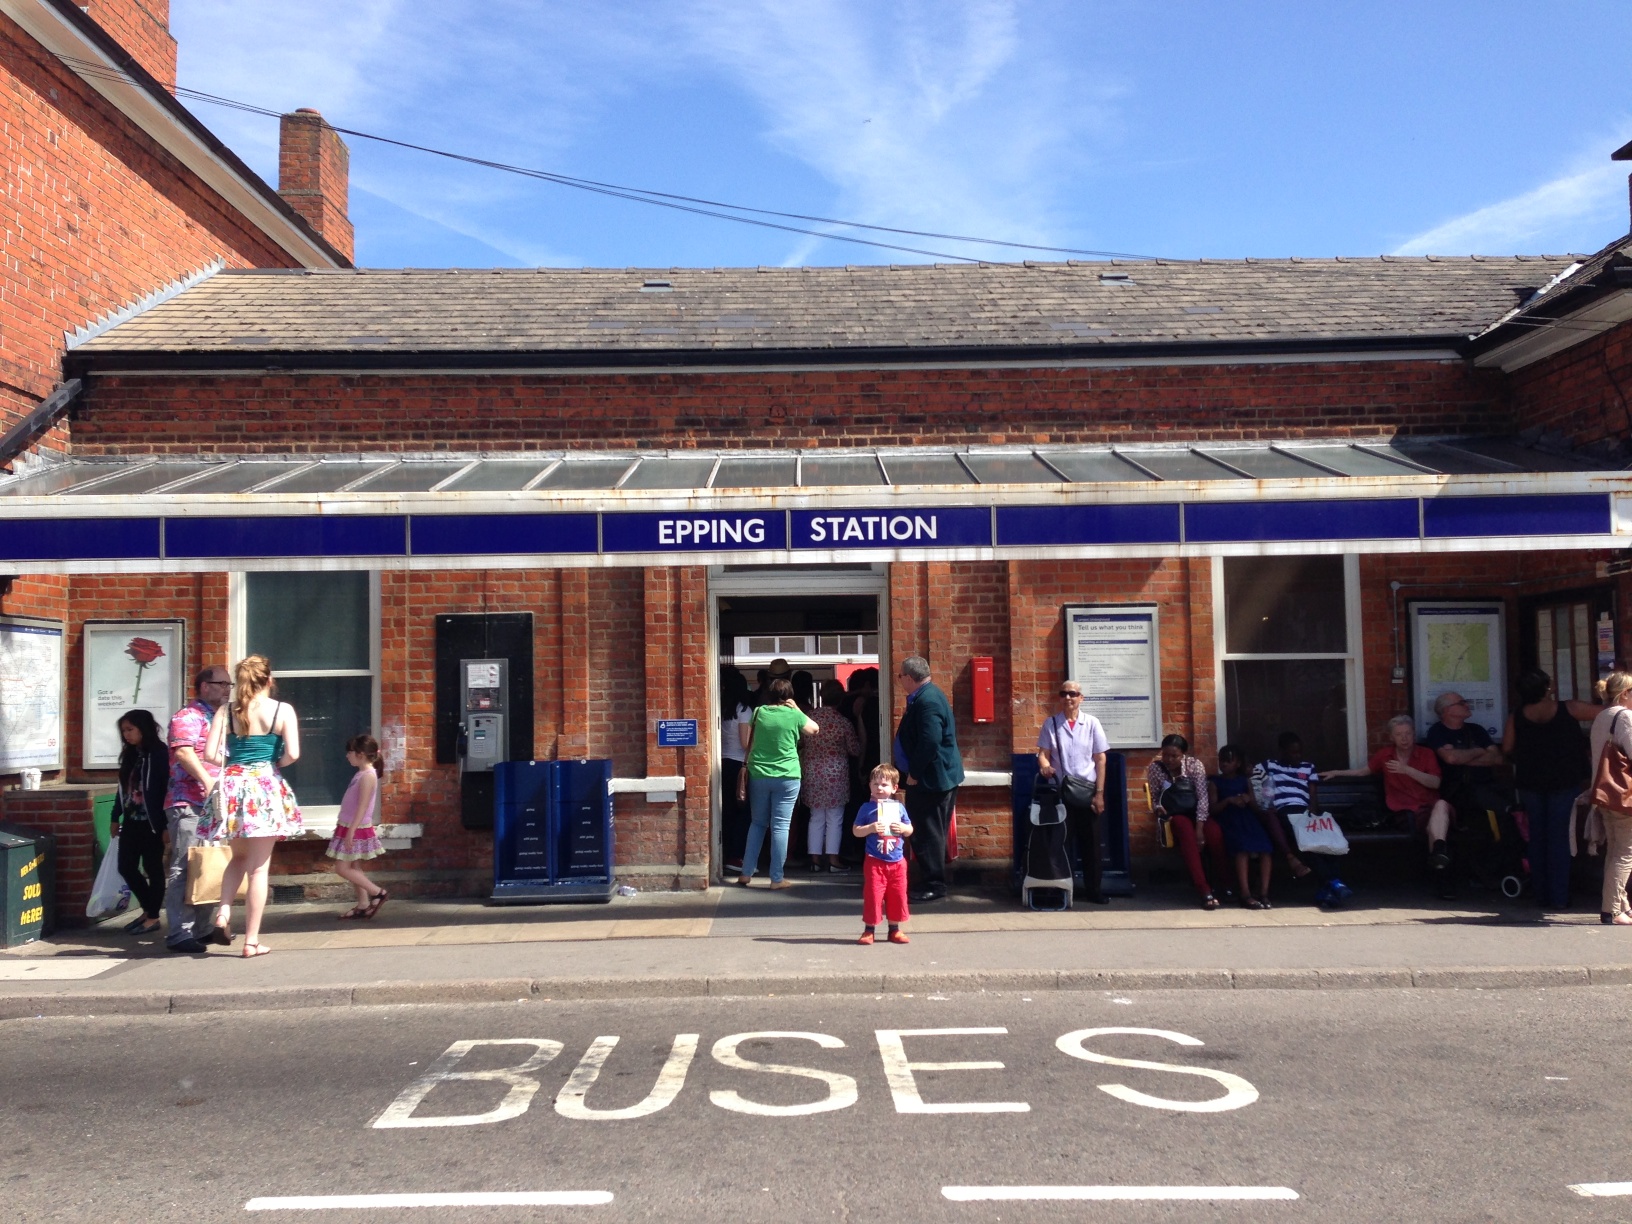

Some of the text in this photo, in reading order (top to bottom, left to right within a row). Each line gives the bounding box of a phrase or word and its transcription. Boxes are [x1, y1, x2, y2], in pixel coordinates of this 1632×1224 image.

[658, 516, 937, 544] EPPING STATION
[23, 883, 41, 901] SOLD
[20, 906, 43, 926] HERE!
[368, 1027, 1261, 1129] BUSES
